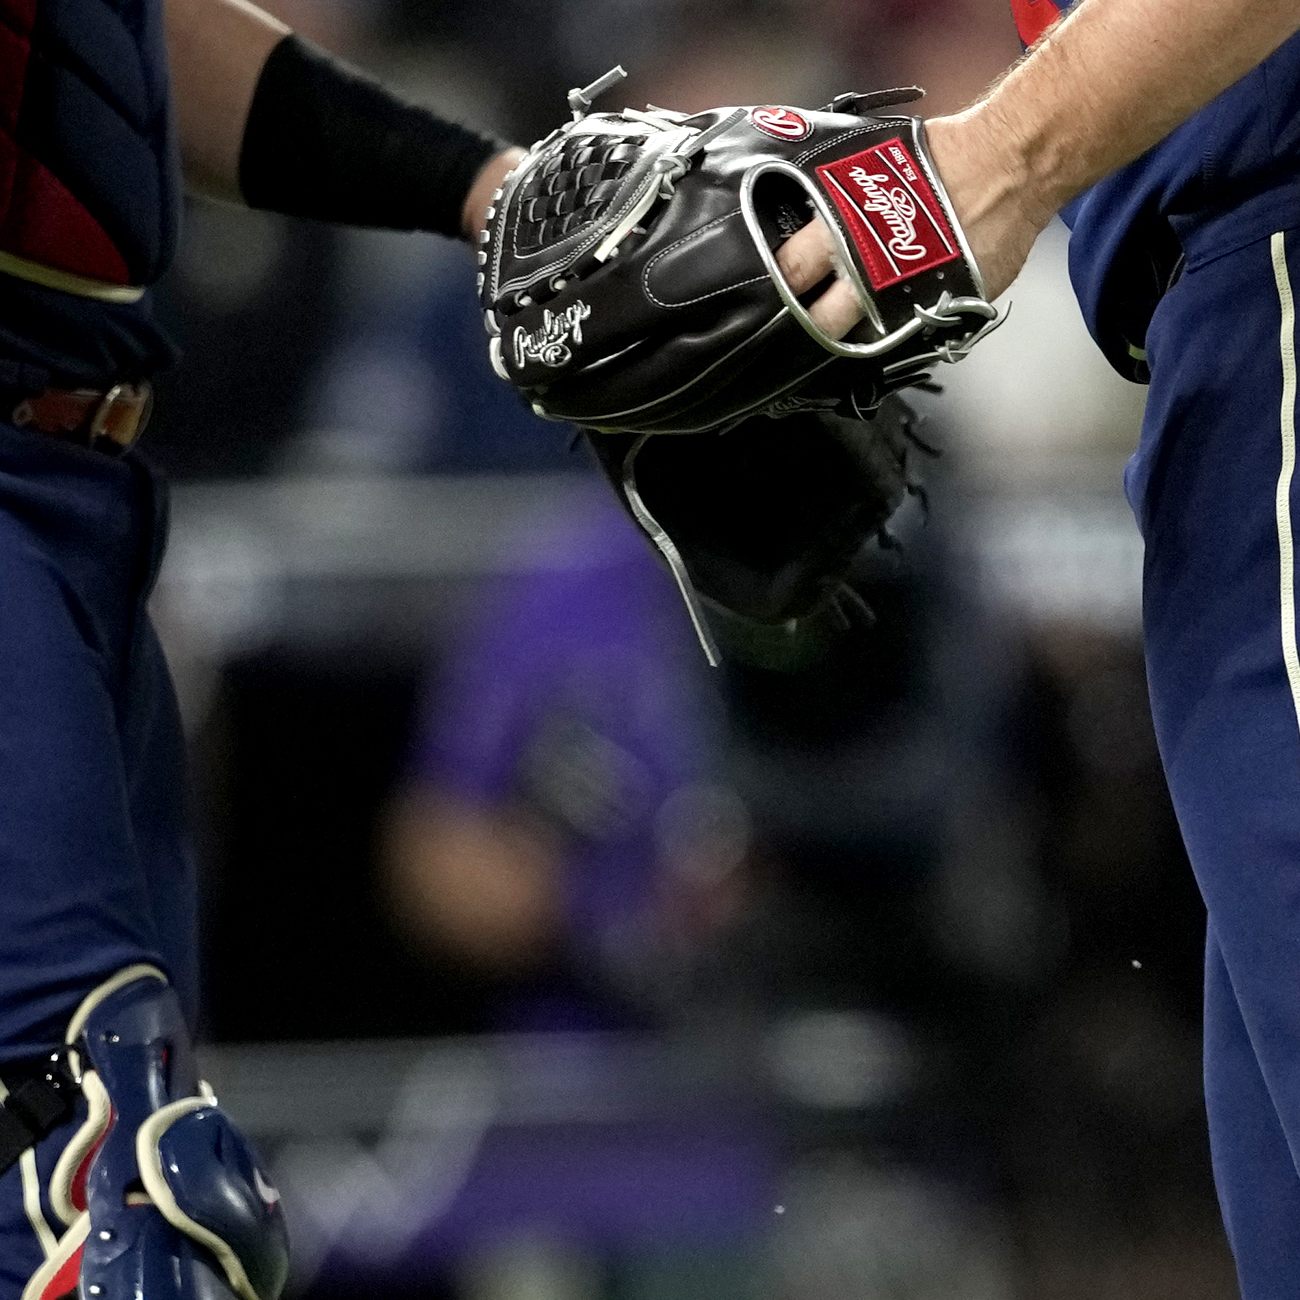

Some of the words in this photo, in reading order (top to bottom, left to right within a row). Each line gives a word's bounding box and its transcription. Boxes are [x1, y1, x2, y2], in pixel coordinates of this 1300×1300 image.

[888, 146, 907, 166] 1887
[848, 166, 928, 260] Rawlings
[513, 299, 592, 369] Rawlings
